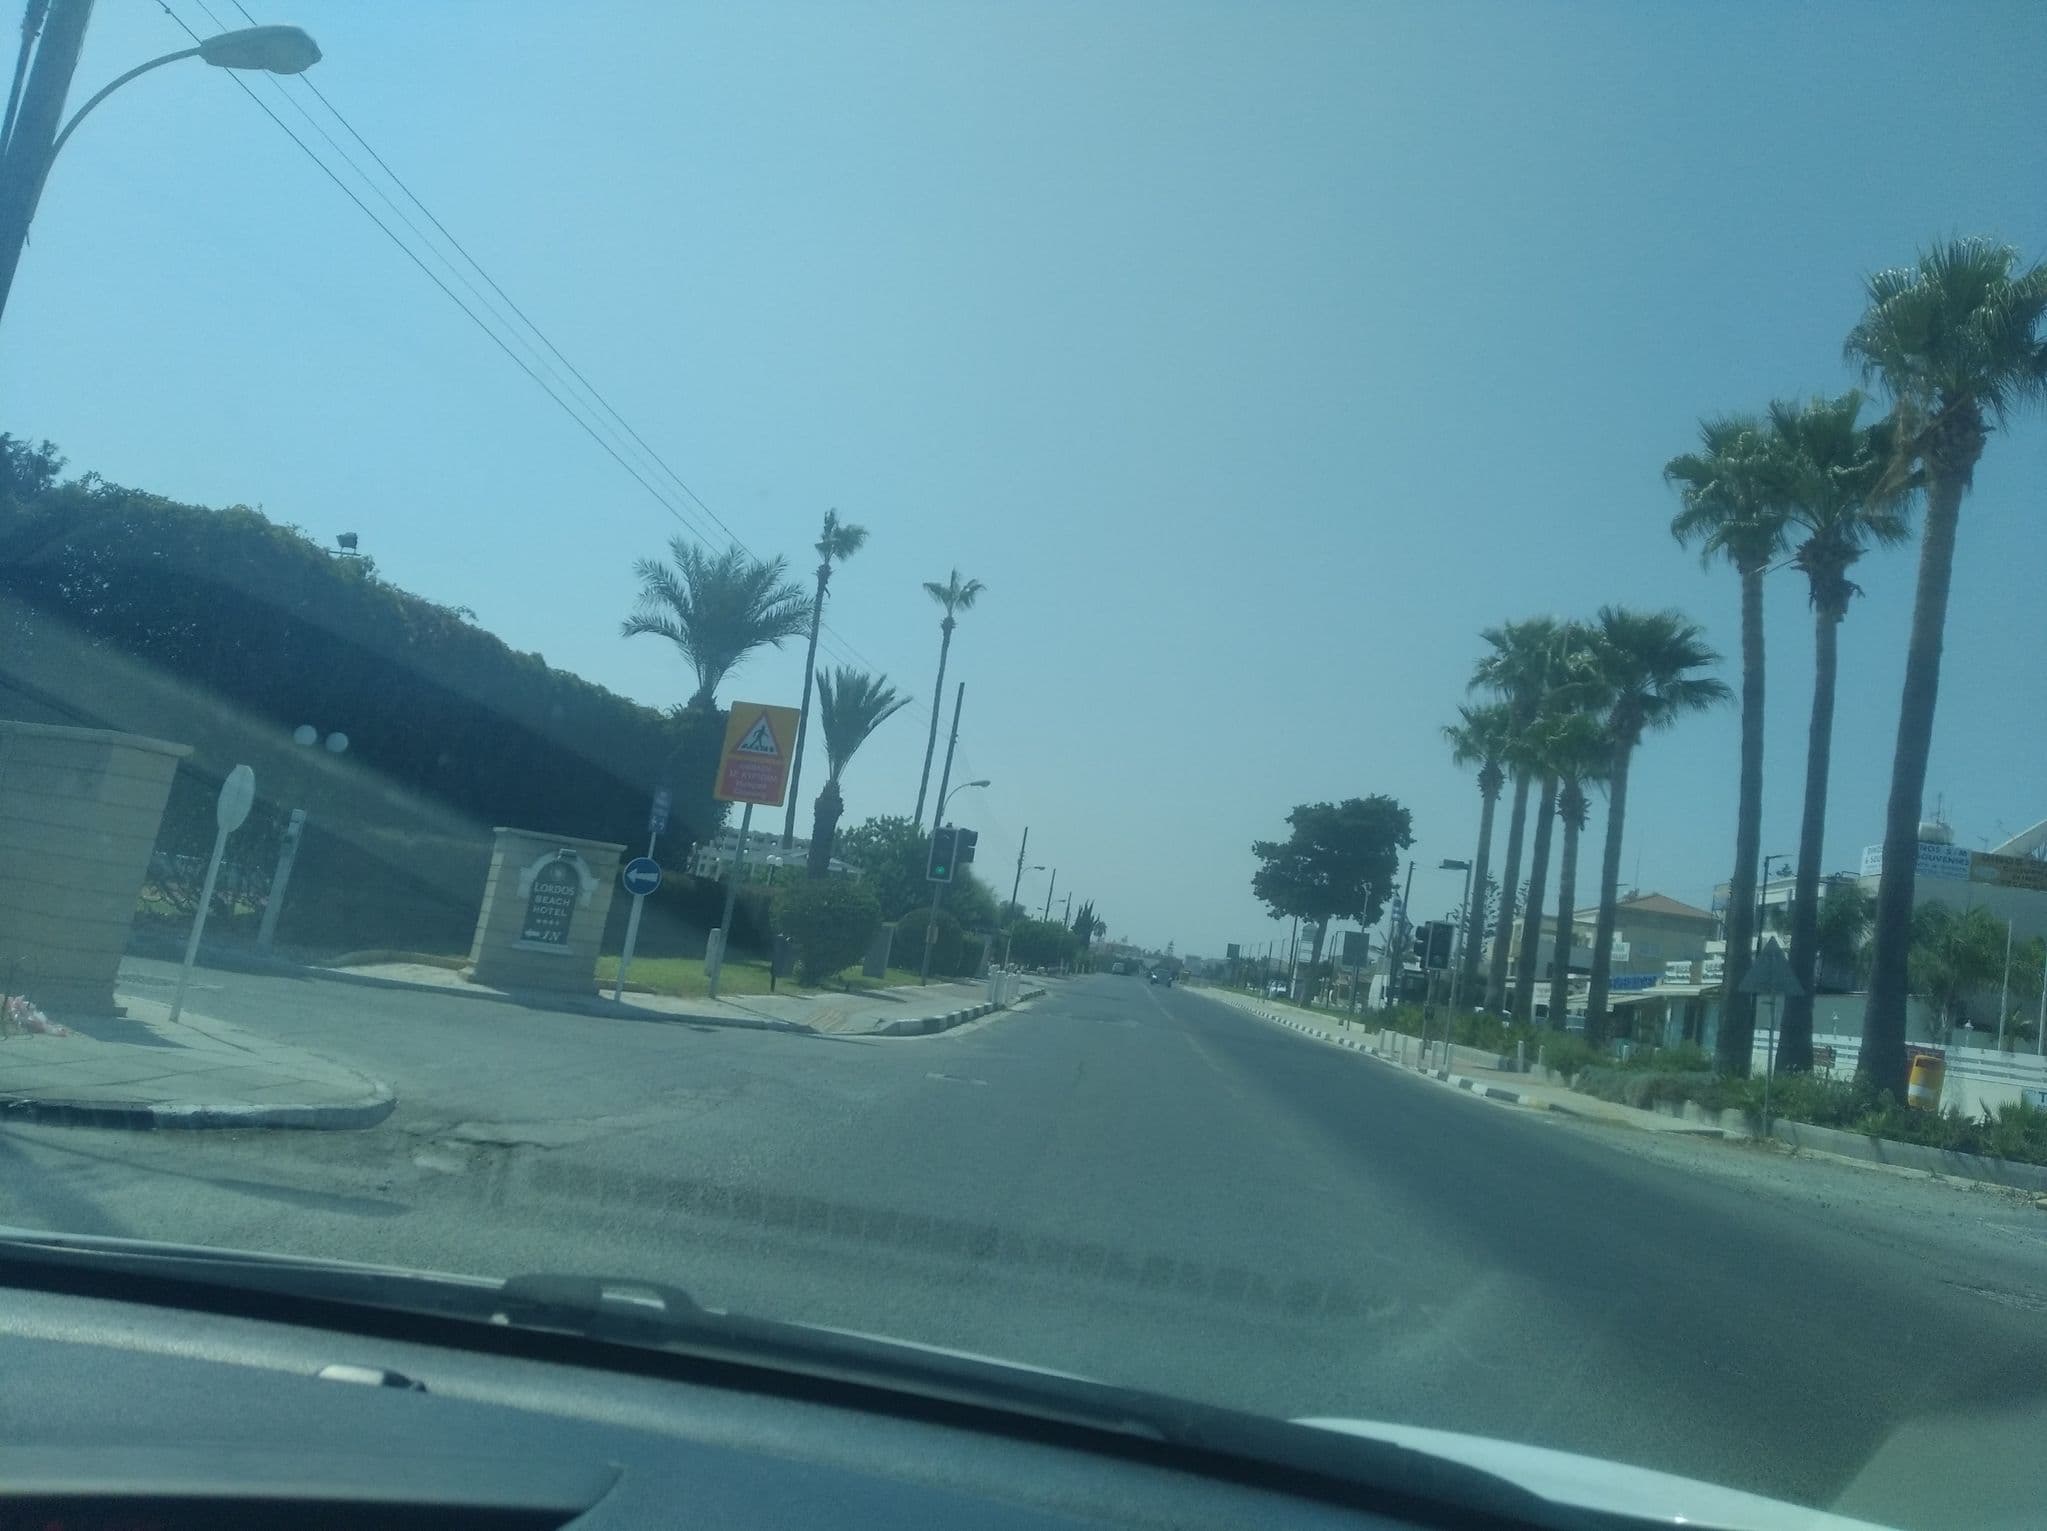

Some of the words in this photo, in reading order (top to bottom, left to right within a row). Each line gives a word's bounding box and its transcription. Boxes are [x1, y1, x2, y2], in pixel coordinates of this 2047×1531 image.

[534, 881, 576, 896] LORDOS
[535, 895, 570, 906] BEACH
[532, 905, 567, 917] HOTEL
[541, 930, 561, 941] IN
